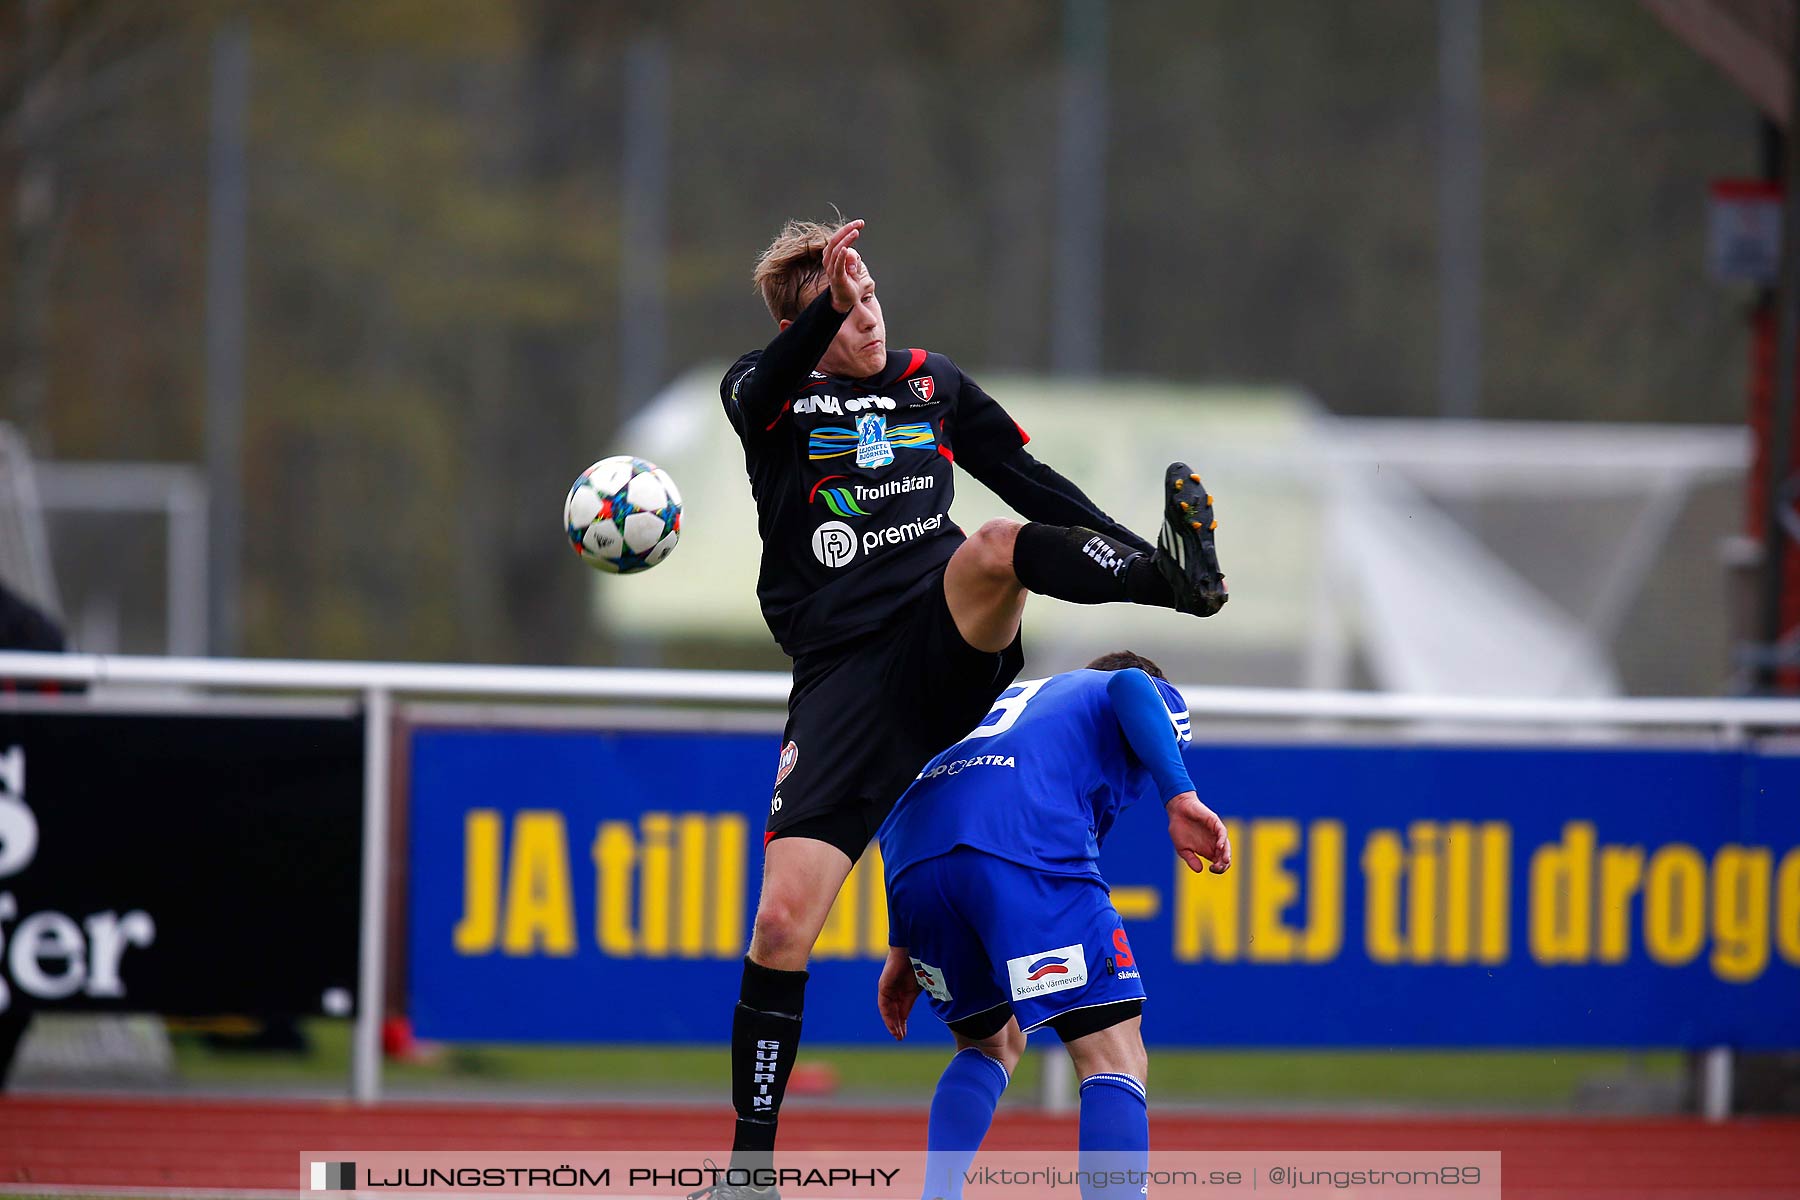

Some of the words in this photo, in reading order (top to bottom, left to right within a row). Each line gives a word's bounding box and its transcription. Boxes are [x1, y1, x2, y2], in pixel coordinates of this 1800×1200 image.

[793, 395, 844, 415] ANA
[862, 513, 943, 556] premier
[964, 755, 1016, 768] EXTRA
[454, 810, 577, 956] JA
[594, 812, 749, 958] till
[1172, 818, 1345, 962] NEJ
[1361, 820, 1512, 965] till
[1016, 983, 1045, 995] Skövde
[1045, 974, 1084, 988] Värmeverk
[753, 1039, 780, 1111] GUHRIN
